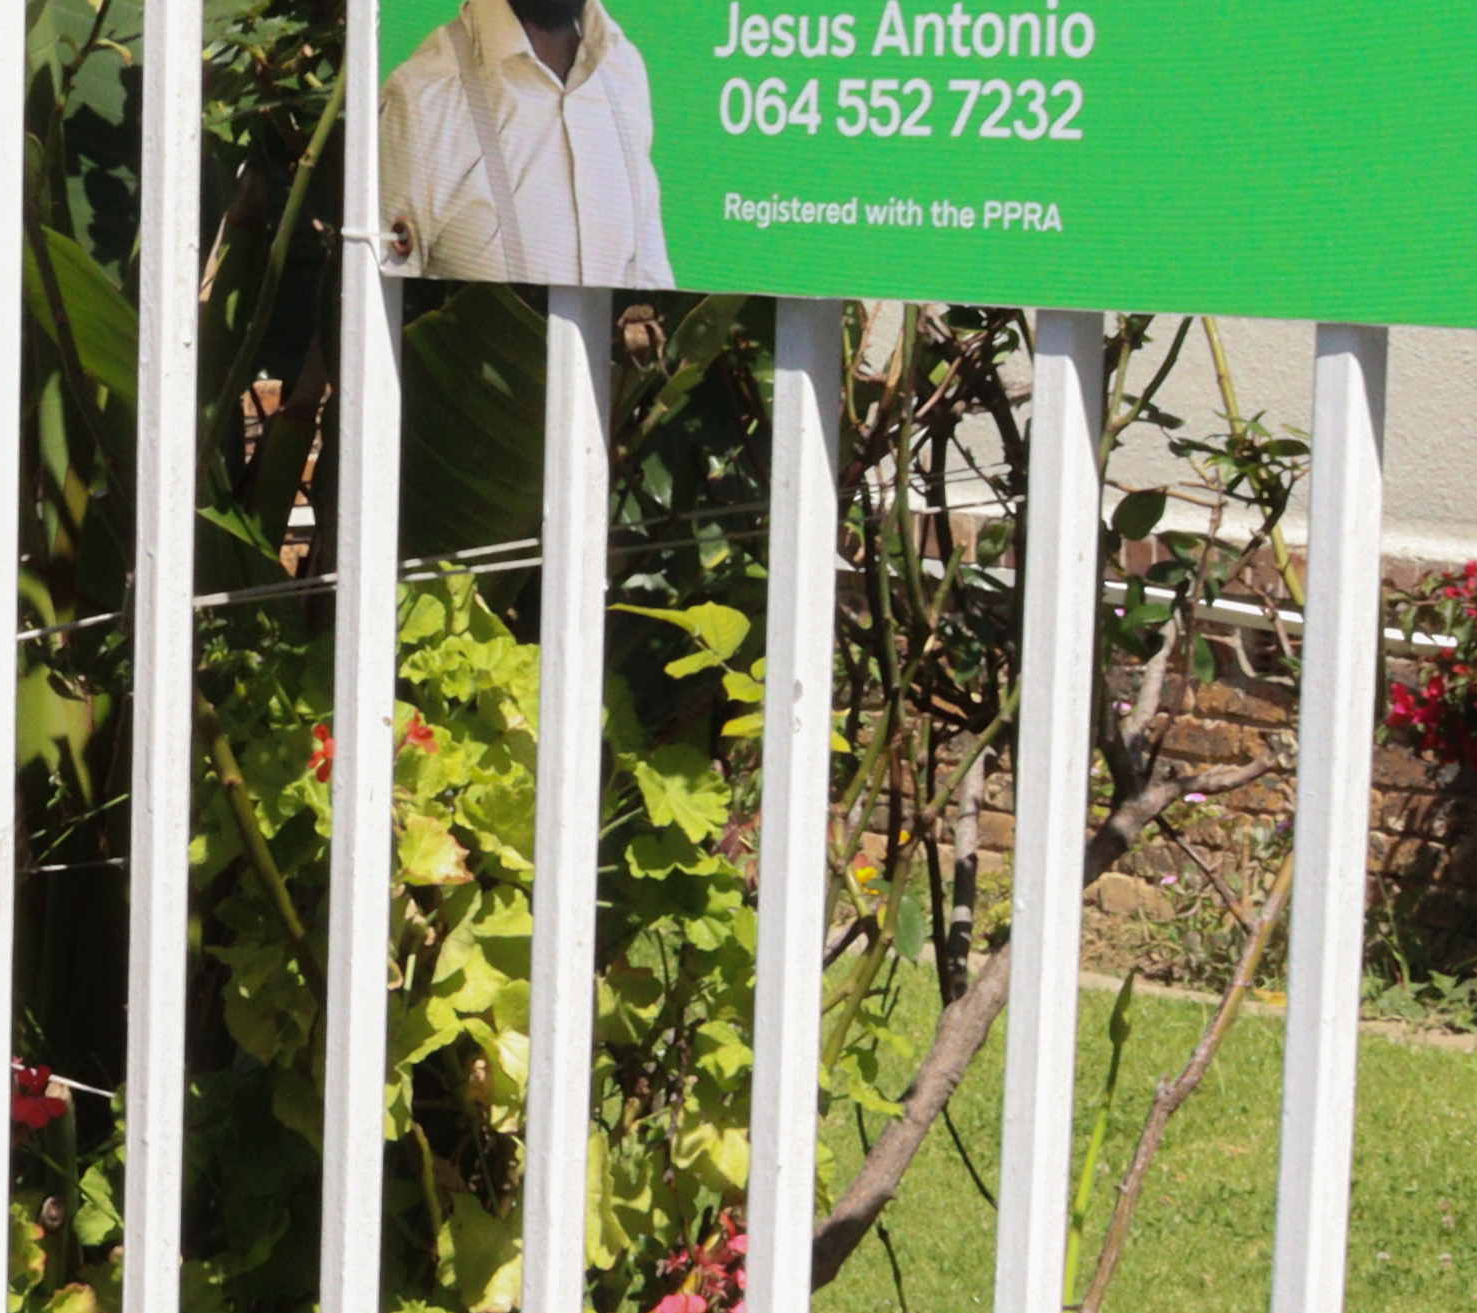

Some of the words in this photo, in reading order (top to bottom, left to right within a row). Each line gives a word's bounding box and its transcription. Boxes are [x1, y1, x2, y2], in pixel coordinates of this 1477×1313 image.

[713, 0, 858, 59] Jesus
[719, 76, 822, 136] 064
[836, 78, 933, 138] 552
[948, 79, 1085, 141] 7232
[724, 192, 858, 229] Registered
[865, 196, 923, 228] with
[931, 198, 977, 229] the
[983, 200, 1064, 232] PPRA
